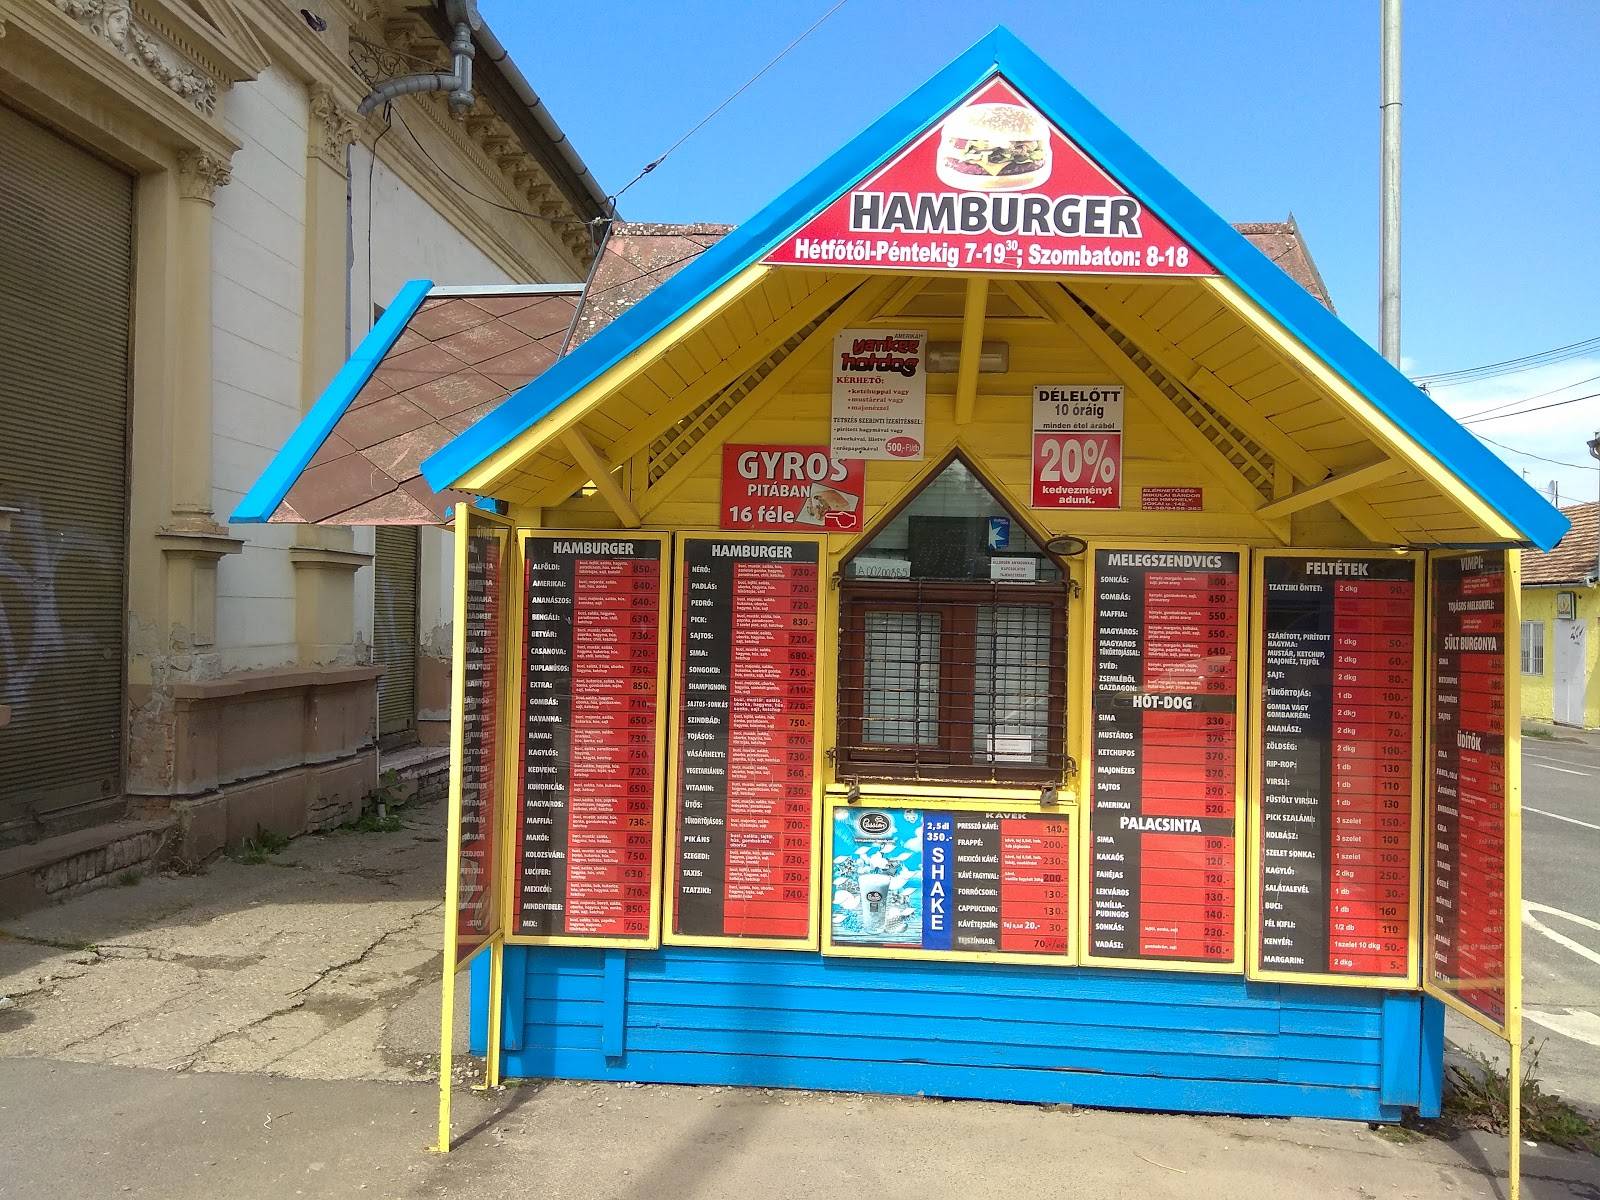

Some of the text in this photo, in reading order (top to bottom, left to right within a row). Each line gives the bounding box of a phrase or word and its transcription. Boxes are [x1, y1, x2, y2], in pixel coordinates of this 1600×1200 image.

[851, 192, 1141, 237] HAMBURGER
[795, 239, 959, 267] Hétfőtől-Péntekig
[1029, 246, 1141, 267] Szombaton:
[1146, 247, 1189, 267] 8-18
[1040, 388, 1120, 401] DÉLELŐTT
[1055, 403, 1104, 418] 10 óráig
[1040, 439, 1115, 483] 20%
[738, 451, 848, 481] GYROS
[748, 481, 810, 498] PITÁBAN
[1043, 486, 1112, 495] kedvezményt
[1059, 496, 1095, 504] adunk.
[730, 505, 795, 523] 16 féle
[553, 542, 634, 554] HAMBURGER
[712, 545, 792, 558] HAMBURGER
[1108, 554, 1221, 568] MELEGSZENDVICS
[692, 565, 710, 573] NÉRÓ:
[1306, 560, 1368, 576] FELTÉTEK
[1101, 575, 1129, 583] SONKÁS:
[692, 582, 717, 590] PADLÁS:
[1300, 584, 1322, 592] ÖNTET:
[532, 596, 571, 604] ANANÁSZOS:
[1101, 592, 1131, 600] GOMBÁS:
[532, 630, 557, 638] BETYÁR:
[1268, 632, 1330, 641] SZÁRÍTOTT, PIRÍTOTT
[1445, 634, 1496, 651] SÜLT BURGONYA
[1268, 649, 1325, 659] MUSTÁR, KETCHUP,
[1100, 662, 1117, 670] SVÉD:
[1267, 671, 1284, 679] SAJT:
[1133, 695, 1192, 709] HOT-DOG
[1267, 711, 1310, 719] GOMBAKRÉM:
[1266, 725, 1301, 733] ANANÁSZ:
[688, 732, 714, 740] TOJÁSOS:
[1099, 731, 1133, 739] MUSTÁROS
[1266, 742, 1297, 750] ZÖLDSÉG:
[529, 748, 558, 756] KAGYLÓS:
[1098, 749, 1135, 757] KETCHUPOS
[1098, 766, 1135, 775] MAJONÉZES
[1266, 778, 1290, 786] VIRSLI:
[1098, 783, 1120, 791] SAJTOS
[527, 800, 563, 808] MAGYAROS:
[1266, 795, 1318, 805] FÜSTÖLT VIRSLI:
[1098, 801, 1130, 809] AMERIKAI
[1206, 805, 1230, 813] 520.-
[1283, 814, 1315, 822] SZALÁMI:
[982, 822, 998, 830] KÁVÉ:
[1120, 816, 1202, 832] PALACSINTA
[1266, 831, 1298, 840] KOLBÁSZ:
[1097, 853, 1124, 861] KAKAÓS
[958, 871, 972, 879] KÁVÉ
[1097, 870, 1123, 879] FAHÉJAS
[1266, 867, 1294, 875] KAGYLÓ:
[931, 847, 945, 930] SHAKE
[958, 887, 997, 896] FORRÓCSOKI:
[1096, 888, 1129, 896] LEKVÁROS
[1265, 884, 1309, 893] SALÁTALEVÉL
[1096, 900, 1125, 909] VANÍLIA-
[1096, 922, 1124, 931] SONKÁS:
[1265, 918, 1275, 927] FÉL
[1096, 940, 1123, 948] VADÁSZ:
[1264, 937, 1293, 946] KENYÉR:
[1264, 956, 1304, 964] MARGARIN:
